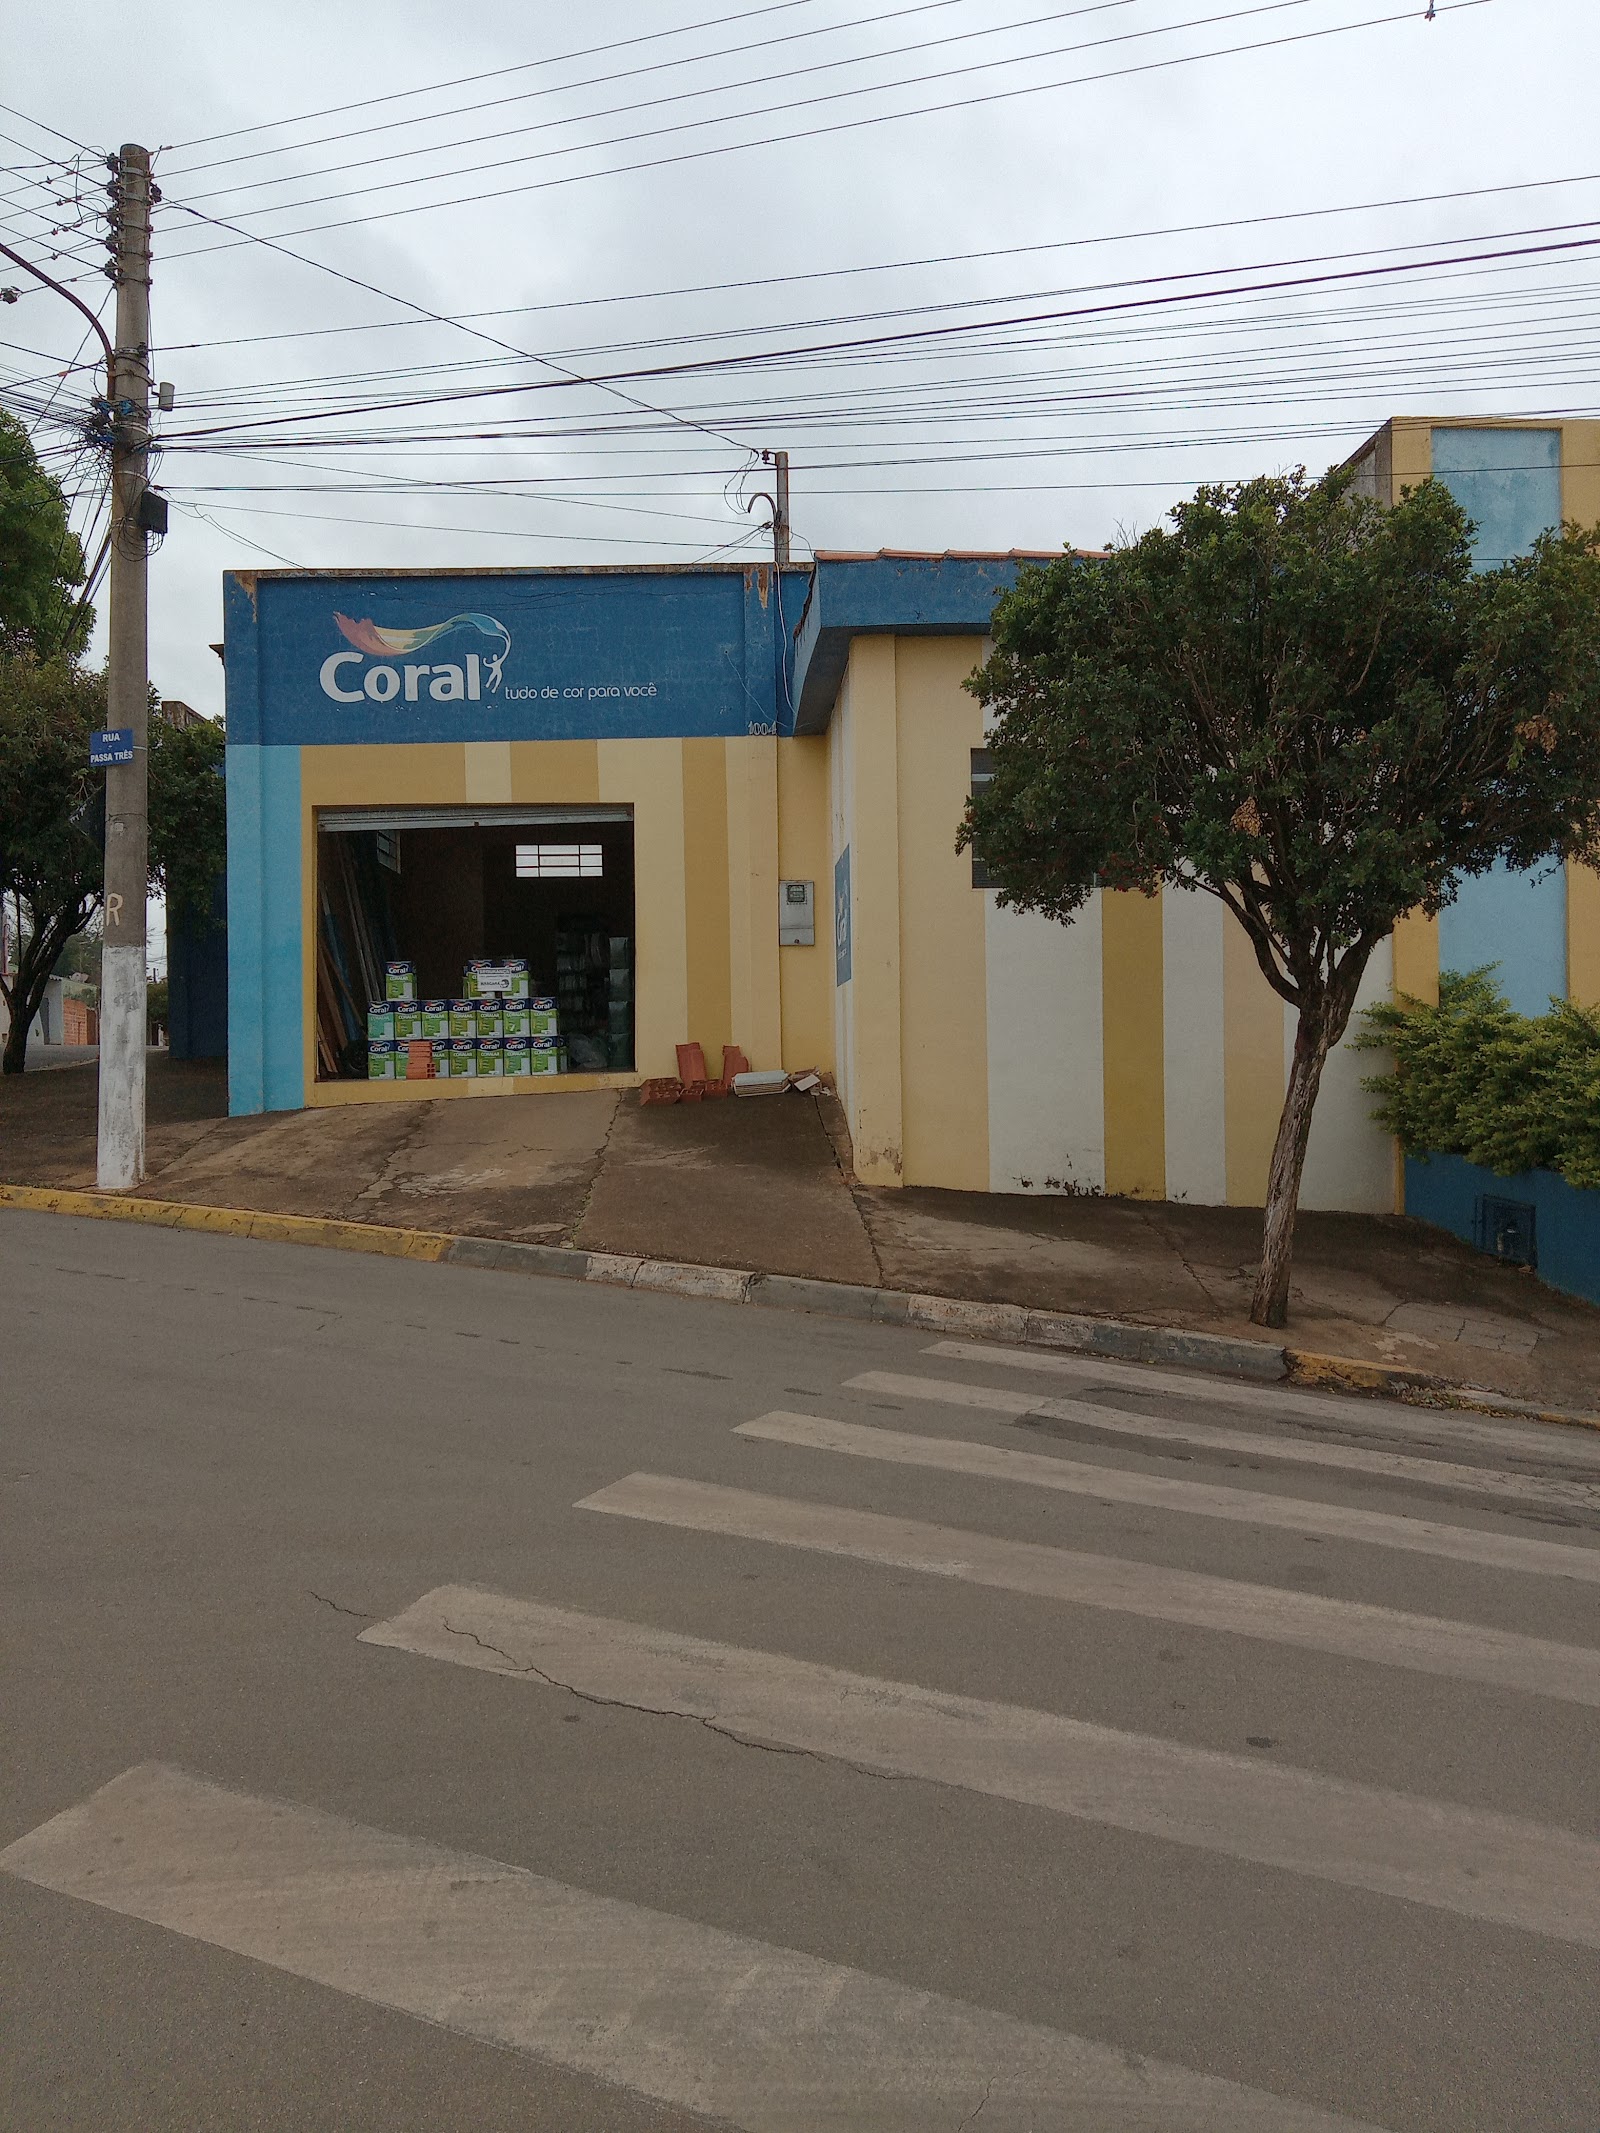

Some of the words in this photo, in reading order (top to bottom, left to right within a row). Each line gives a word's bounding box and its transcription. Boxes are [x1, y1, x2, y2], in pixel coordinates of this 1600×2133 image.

[319, 651, 481, 703] Coral
[505, 686, 537, 700] tudo
[540, 686, 559, 699] de
[563, 687, 584, 699] cor
[588, 687, 620, 702] para
[624, 683, 657, 698] você
[748, 720, 777, 735] 1004
[102, 733, 120, 743] RUA
[90, 752, 113, 764] PASSA
[114, 749, 133, 761] TRÊS
[105, 892, 124, 927] R
